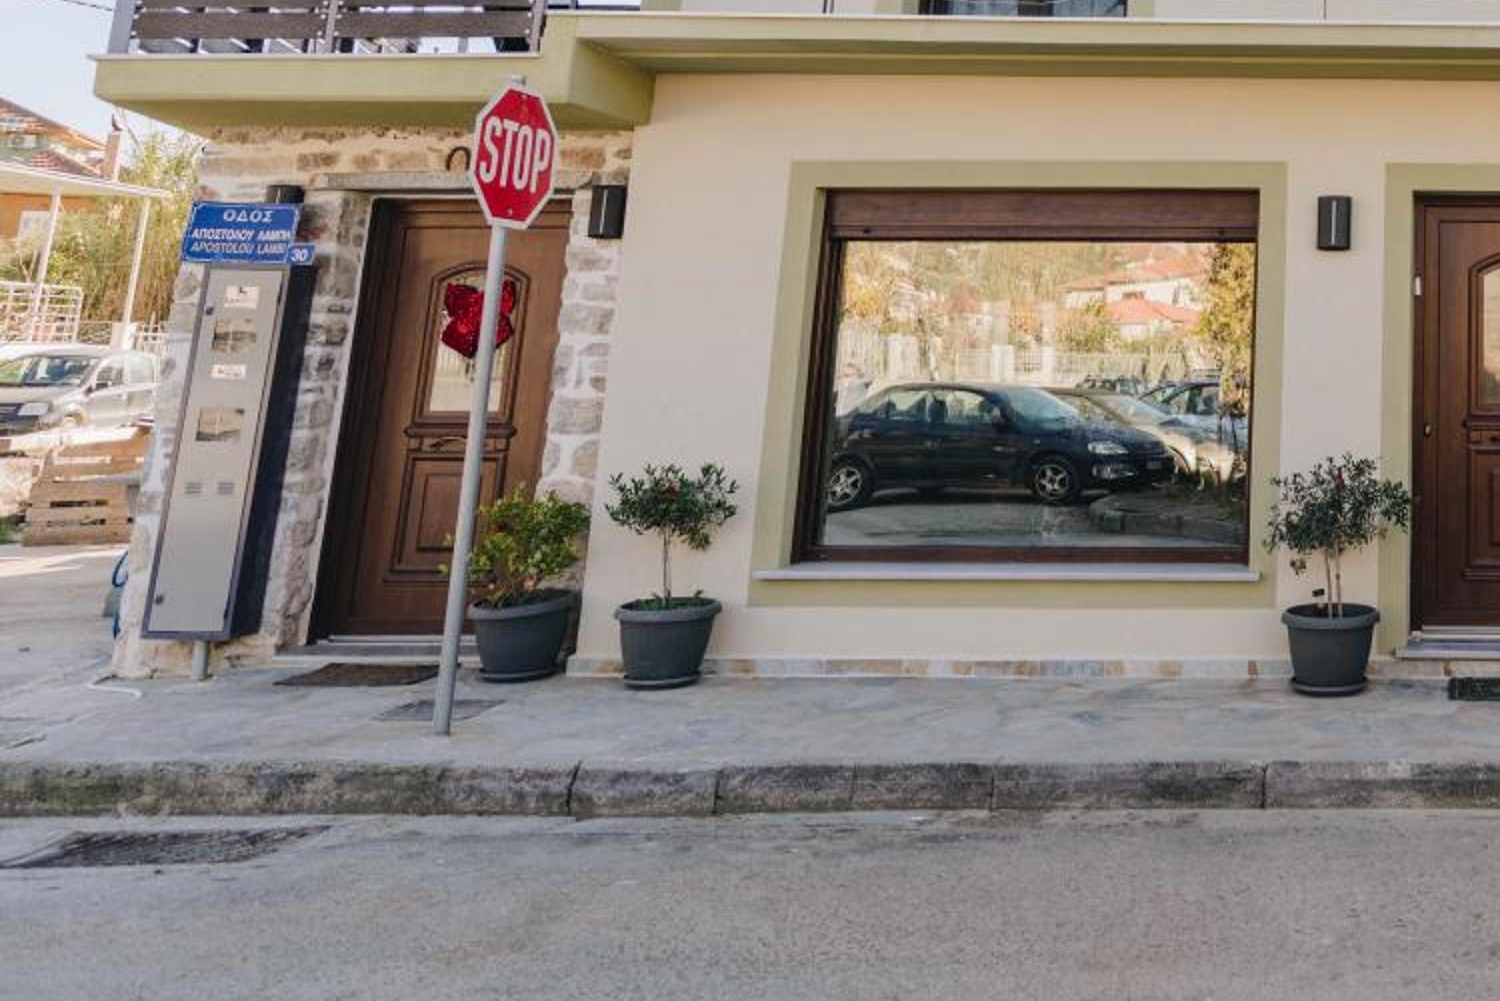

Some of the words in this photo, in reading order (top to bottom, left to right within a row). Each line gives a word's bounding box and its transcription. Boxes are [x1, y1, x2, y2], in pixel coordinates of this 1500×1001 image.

[479, 116, 551, 194] STOP
[223, 209, 273, 223] ΟΔΟΣ
[191, 228, 254, 241] ΑΠΟΣΤΟΛΟΥ
[190, 241, 254, 254] APOSTOLOU
[291, 248, 308, 262] 30
